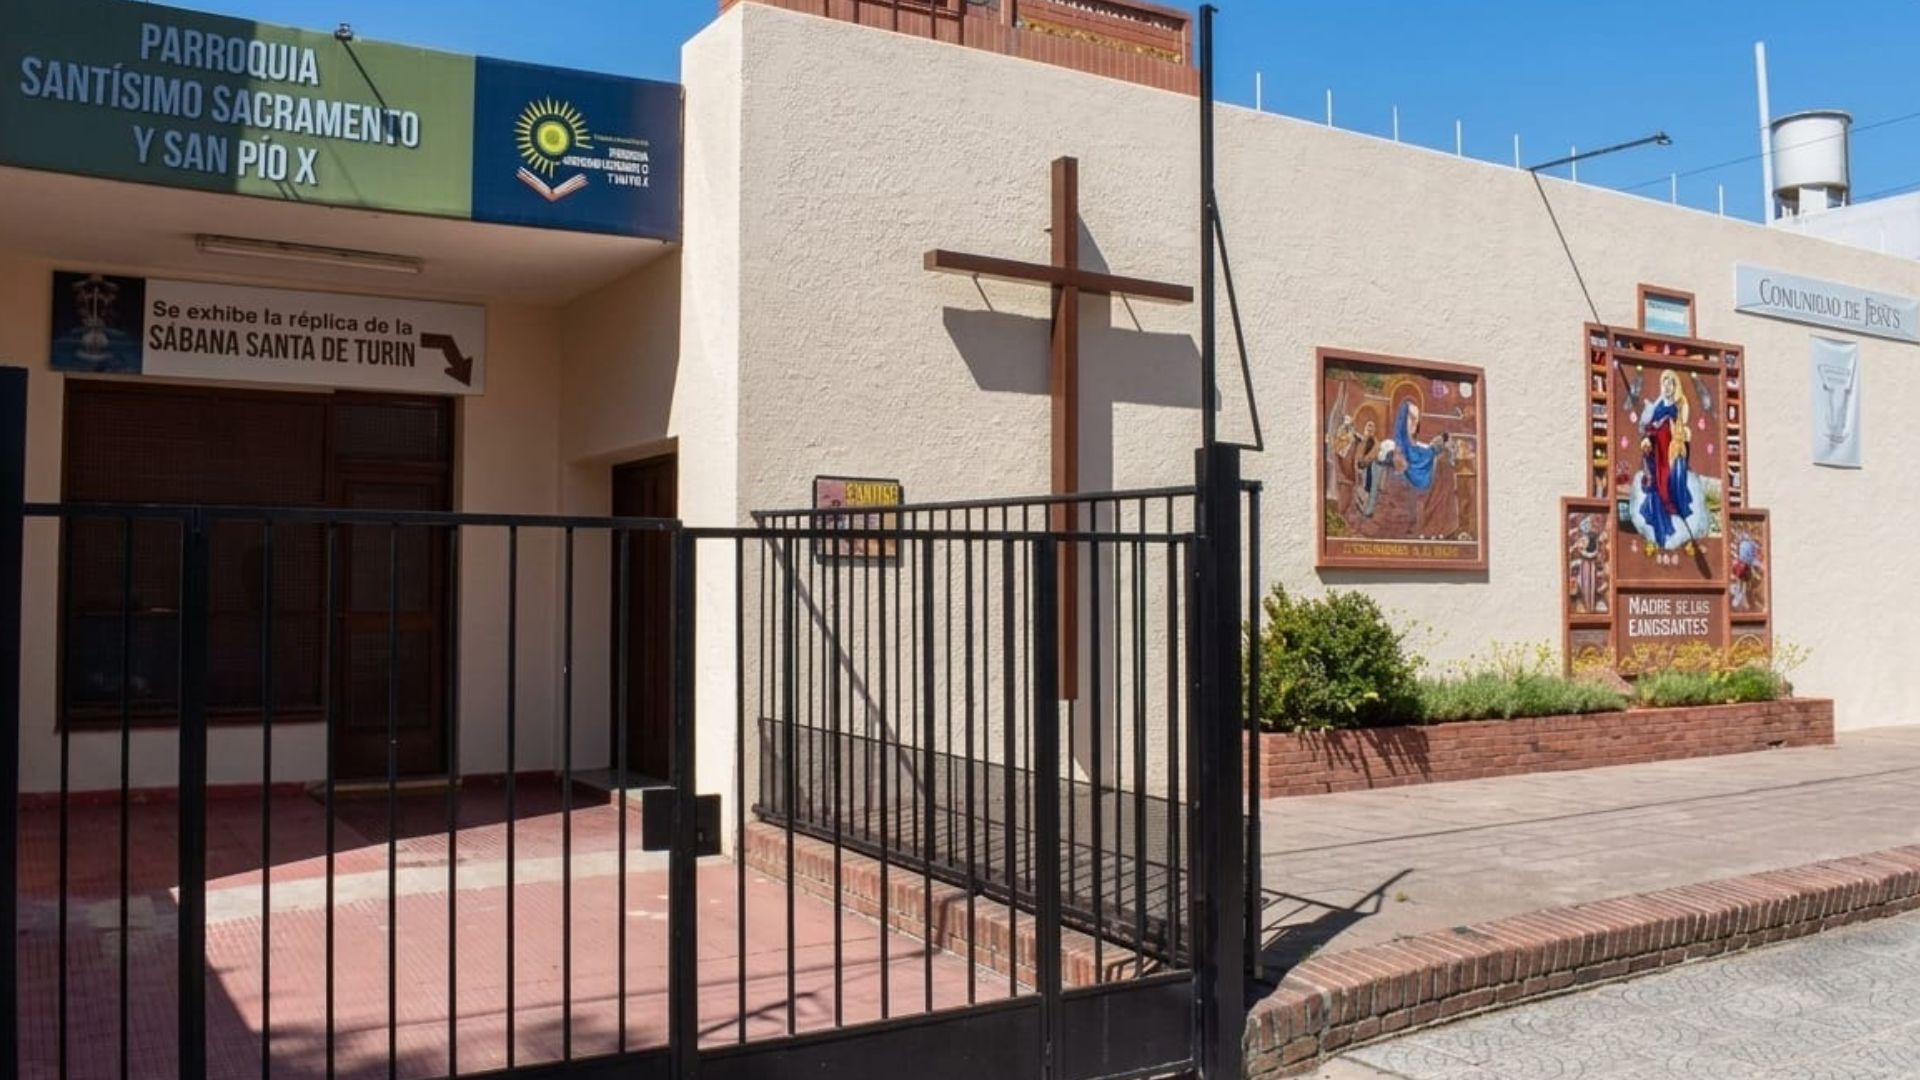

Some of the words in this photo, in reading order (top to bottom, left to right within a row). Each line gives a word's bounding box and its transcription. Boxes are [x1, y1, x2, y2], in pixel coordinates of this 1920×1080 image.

[140, 22, 319, 86] PARROQUIA
[20, 56, 204, 119] SANTÍSIMO
[211, 84, 420, 148] SACRAMENTO
[133, 125, 154, 164] Y
[163, 130, 228, 174] SAN
[237, 134, 288, 181] PÍO
[295, 147, 318, 186] X
[149, 321, 240, 356] SÁBANA
[246, 331, 315, 361] SANTA
[322, 336, 349, 363] DE
[354, 339, 415, 367] TURIN
[152, 300, 180, 318] Se
[186, 304, 258, 324] exhibe
[264, 307, 282, 326] la
[289, 311, 358, 332] réplica
[364, 316, 389, 334] de
[395, 319, 413, 336] la
